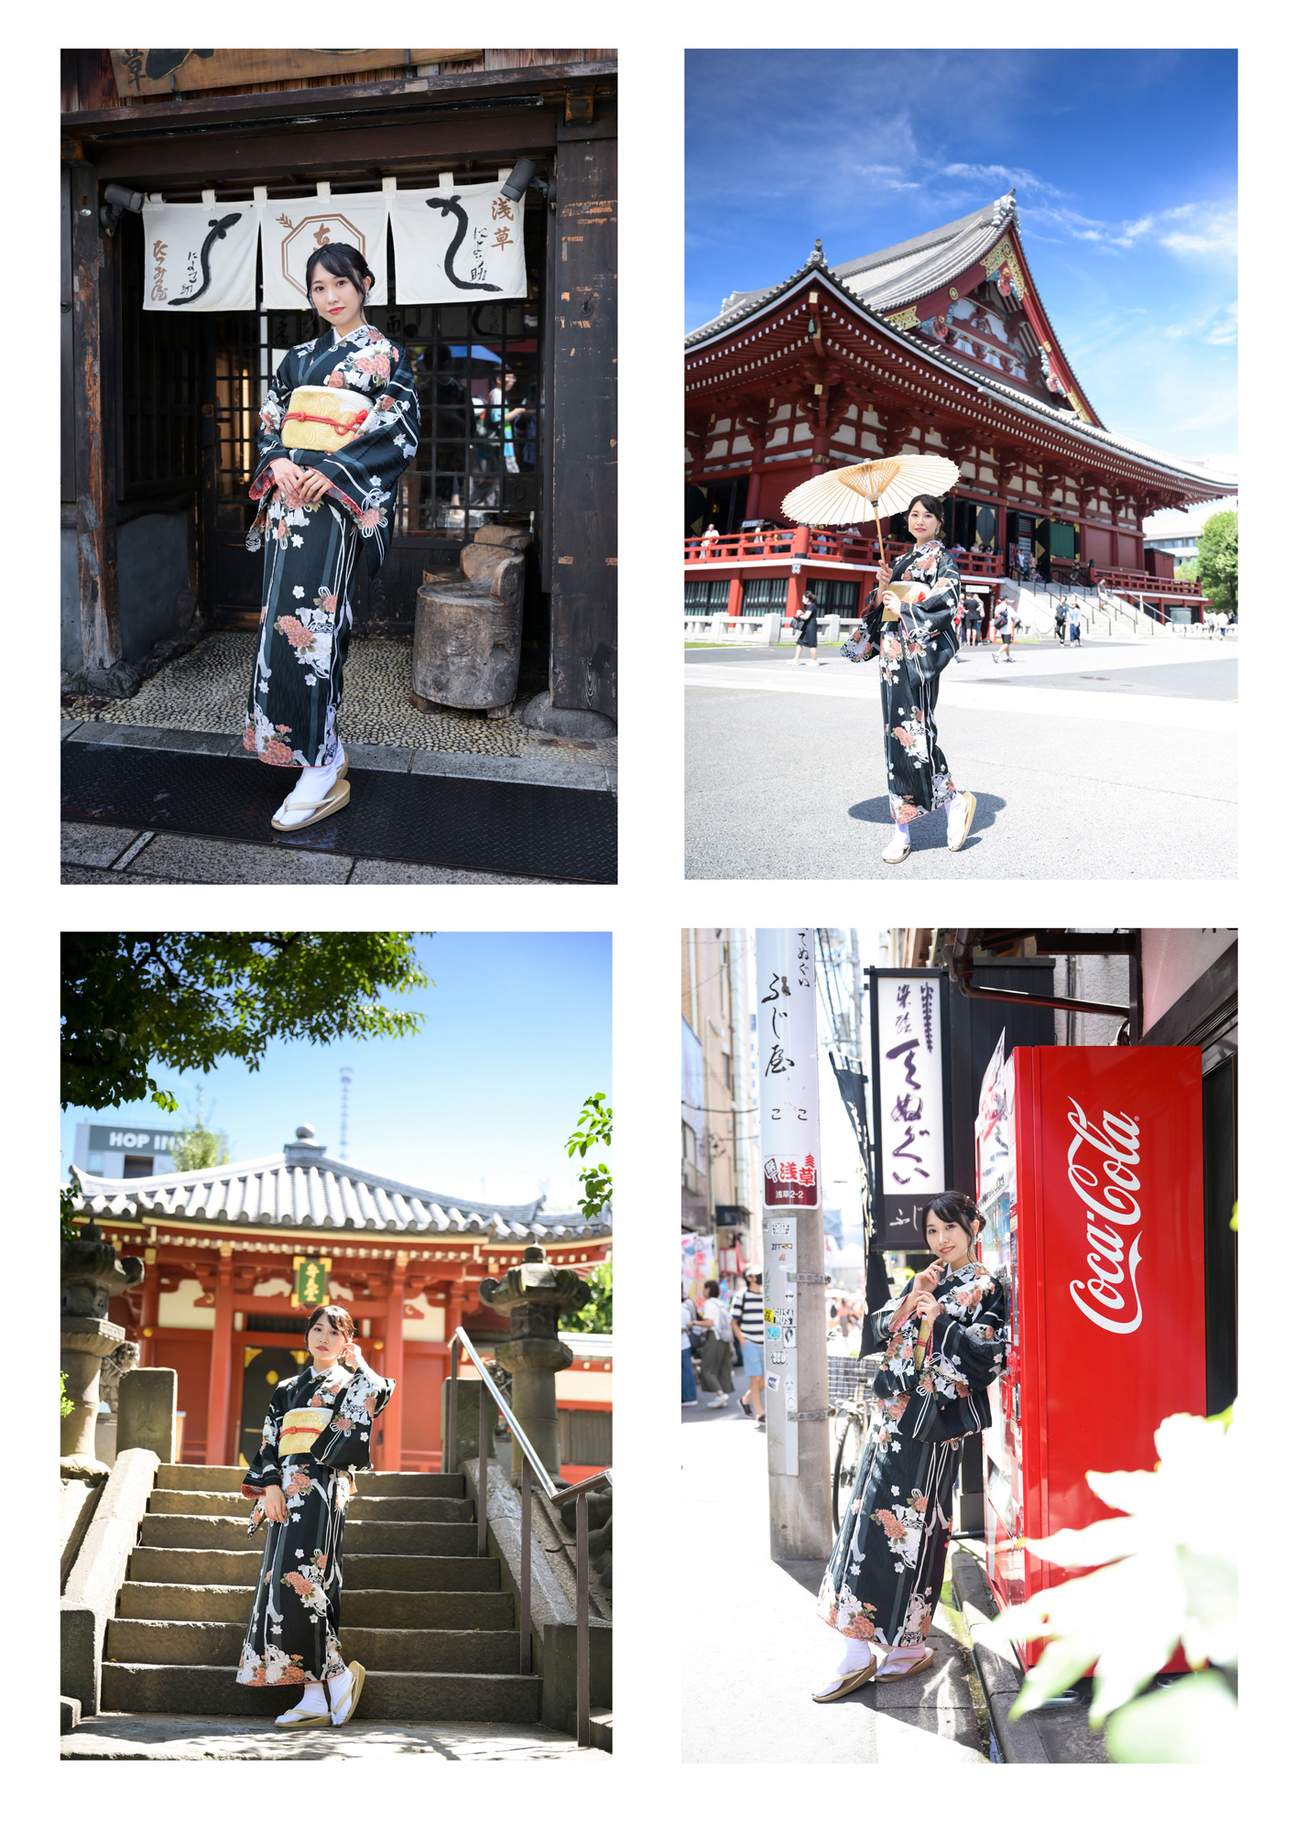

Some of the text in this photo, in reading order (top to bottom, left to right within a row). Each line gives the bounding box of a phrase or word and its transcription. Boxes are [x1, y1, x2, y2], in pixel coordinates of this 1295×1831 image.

[491, 197, 514, 252] 浅草
[109, 1131, 150, 1148] HOP
[779, 1161, 815, 1186] 浅草
[1067, 1095, 1143, 1334] Coca-Cola
